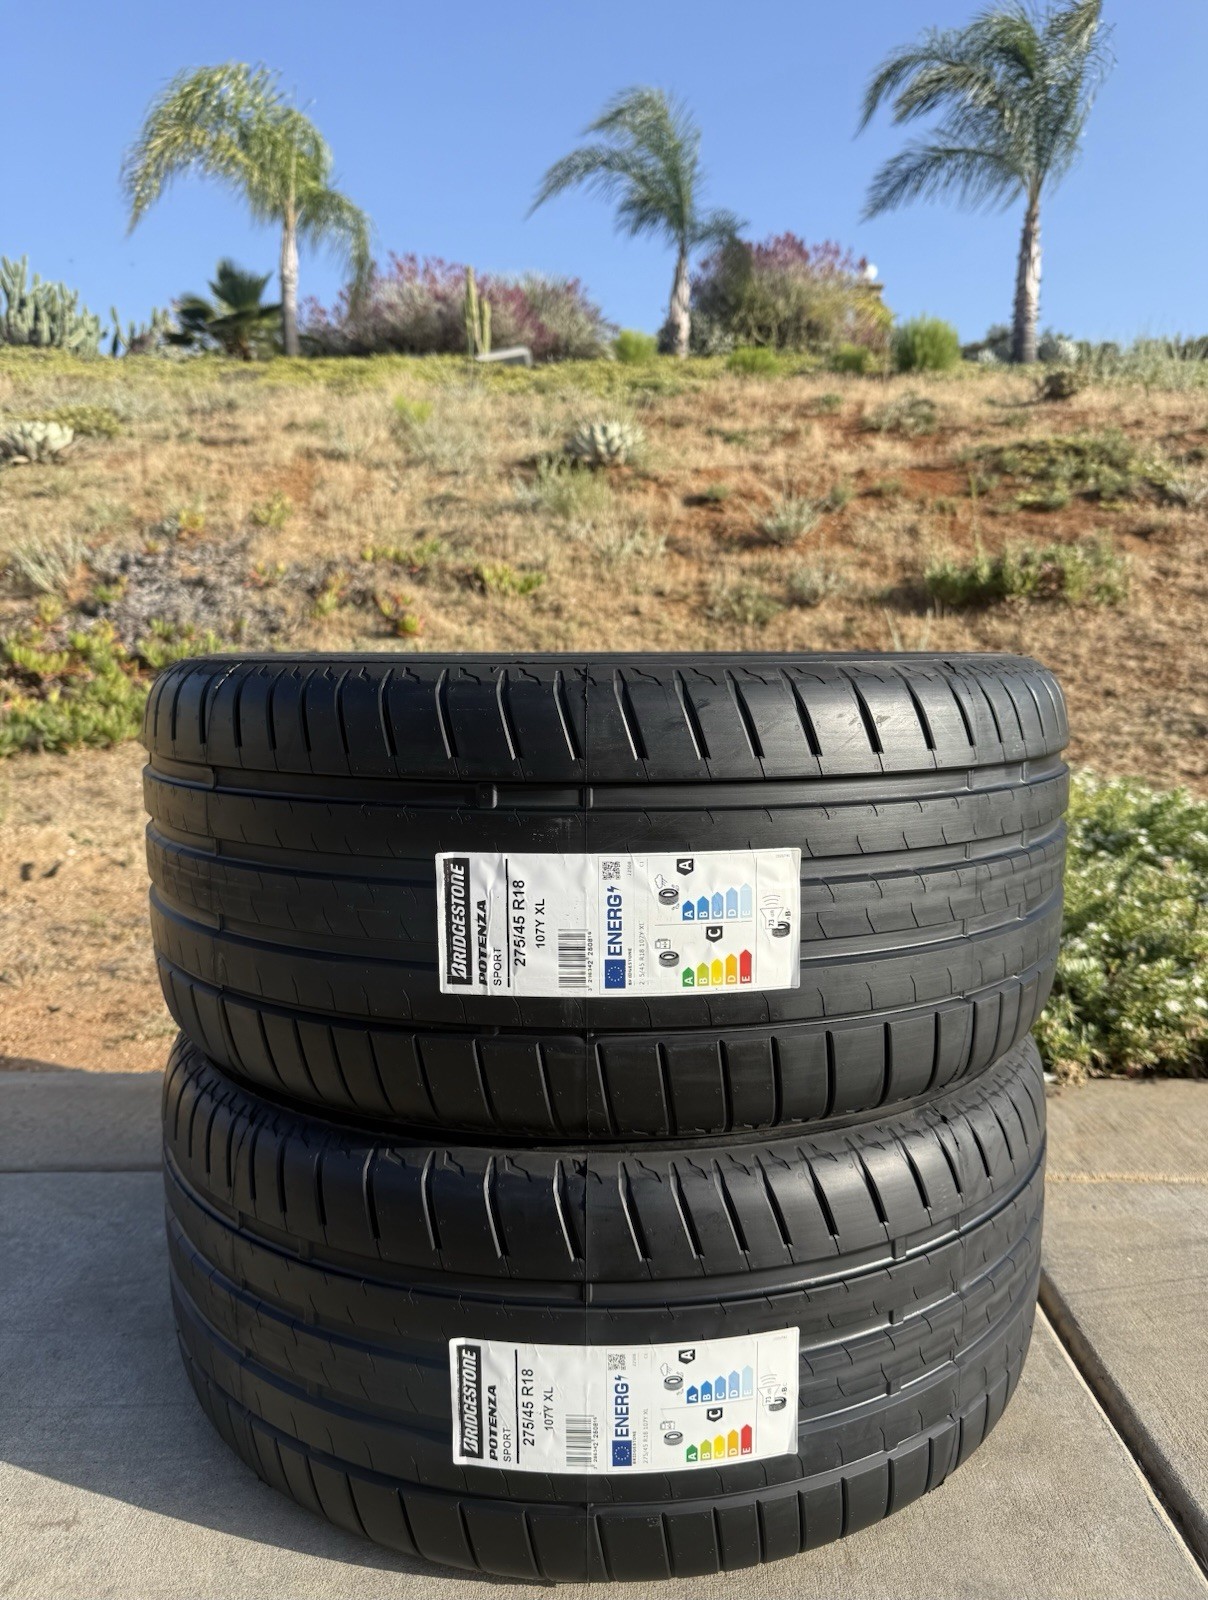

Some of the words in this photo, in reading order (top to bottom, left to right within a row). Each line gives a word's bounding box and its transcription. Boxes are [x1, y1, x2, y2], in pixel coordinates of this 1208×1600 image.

[678, 860, 692, 870] A
[513, 880, 525, 910] R18
[535, 899, 545, 914] XL
[450, 864, 466, 979] BRIDGESTONE
[607, 895, 622, 956] ENERG
[684, 910, 693, 918] A
[477, 900, 487, 986] POTENZA
[514, 916, 525, 966] 275/45
[536, 920, 545, 948] 107Y
[708, 928, 721, 938] C
[493, 948, 501, 986] SPORT
[684, 976, 693, 985] A
[713, 976, 722, 984] C
[680, 1350, 693, 1360] A
[522, 1369, 533, 1396] R18
[543, 1387, 553, 1401] XL
[462, 1349, 478, 1453] BRIDGESTONE
[615, 1383, 629, 1437] ENERG
[709, 1410, 721, 1418] C
[488, 1385, 498, 1461] POTENZA
[522, 1402, 534, 1446] 275/45
[544, 1405, 553, 1430] 107Y
[503, 1428, 511, 1462] SPORT
[688, 1452, 696, 1460] A
